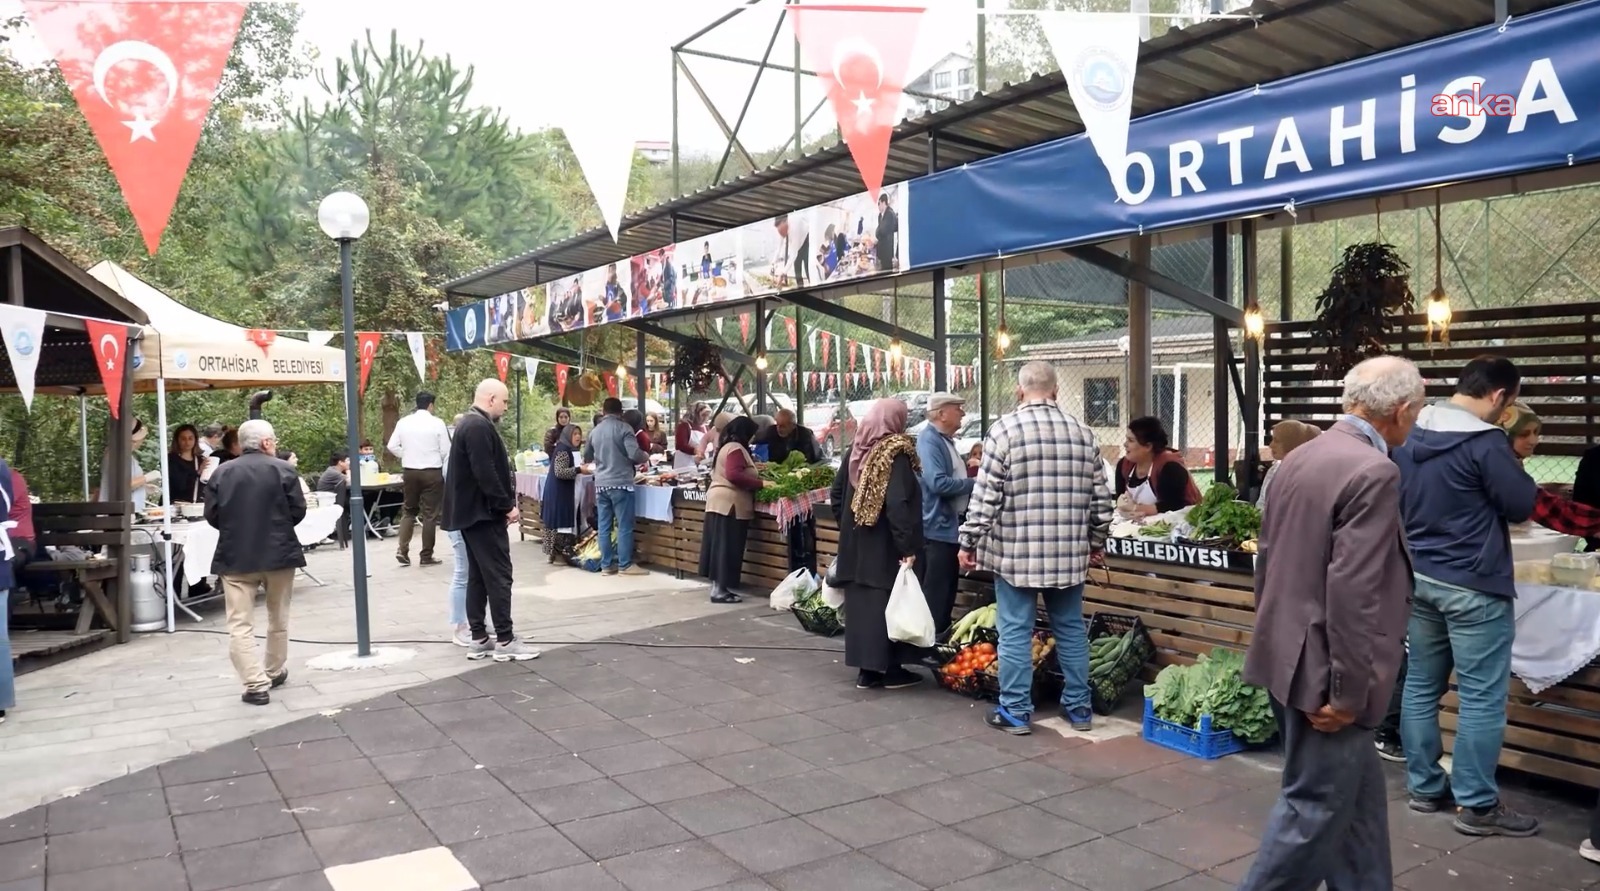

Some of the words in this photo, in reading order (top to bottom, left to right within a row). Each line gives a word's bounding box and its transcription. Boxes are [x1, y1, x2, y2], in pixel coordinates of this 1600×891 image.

[199, 354, 260, 373] ORTAHİSAR
[273, 357, 324, 375] BELEDİYESİ
[1121, 540, 1229, 569] BELEDİYESİ
